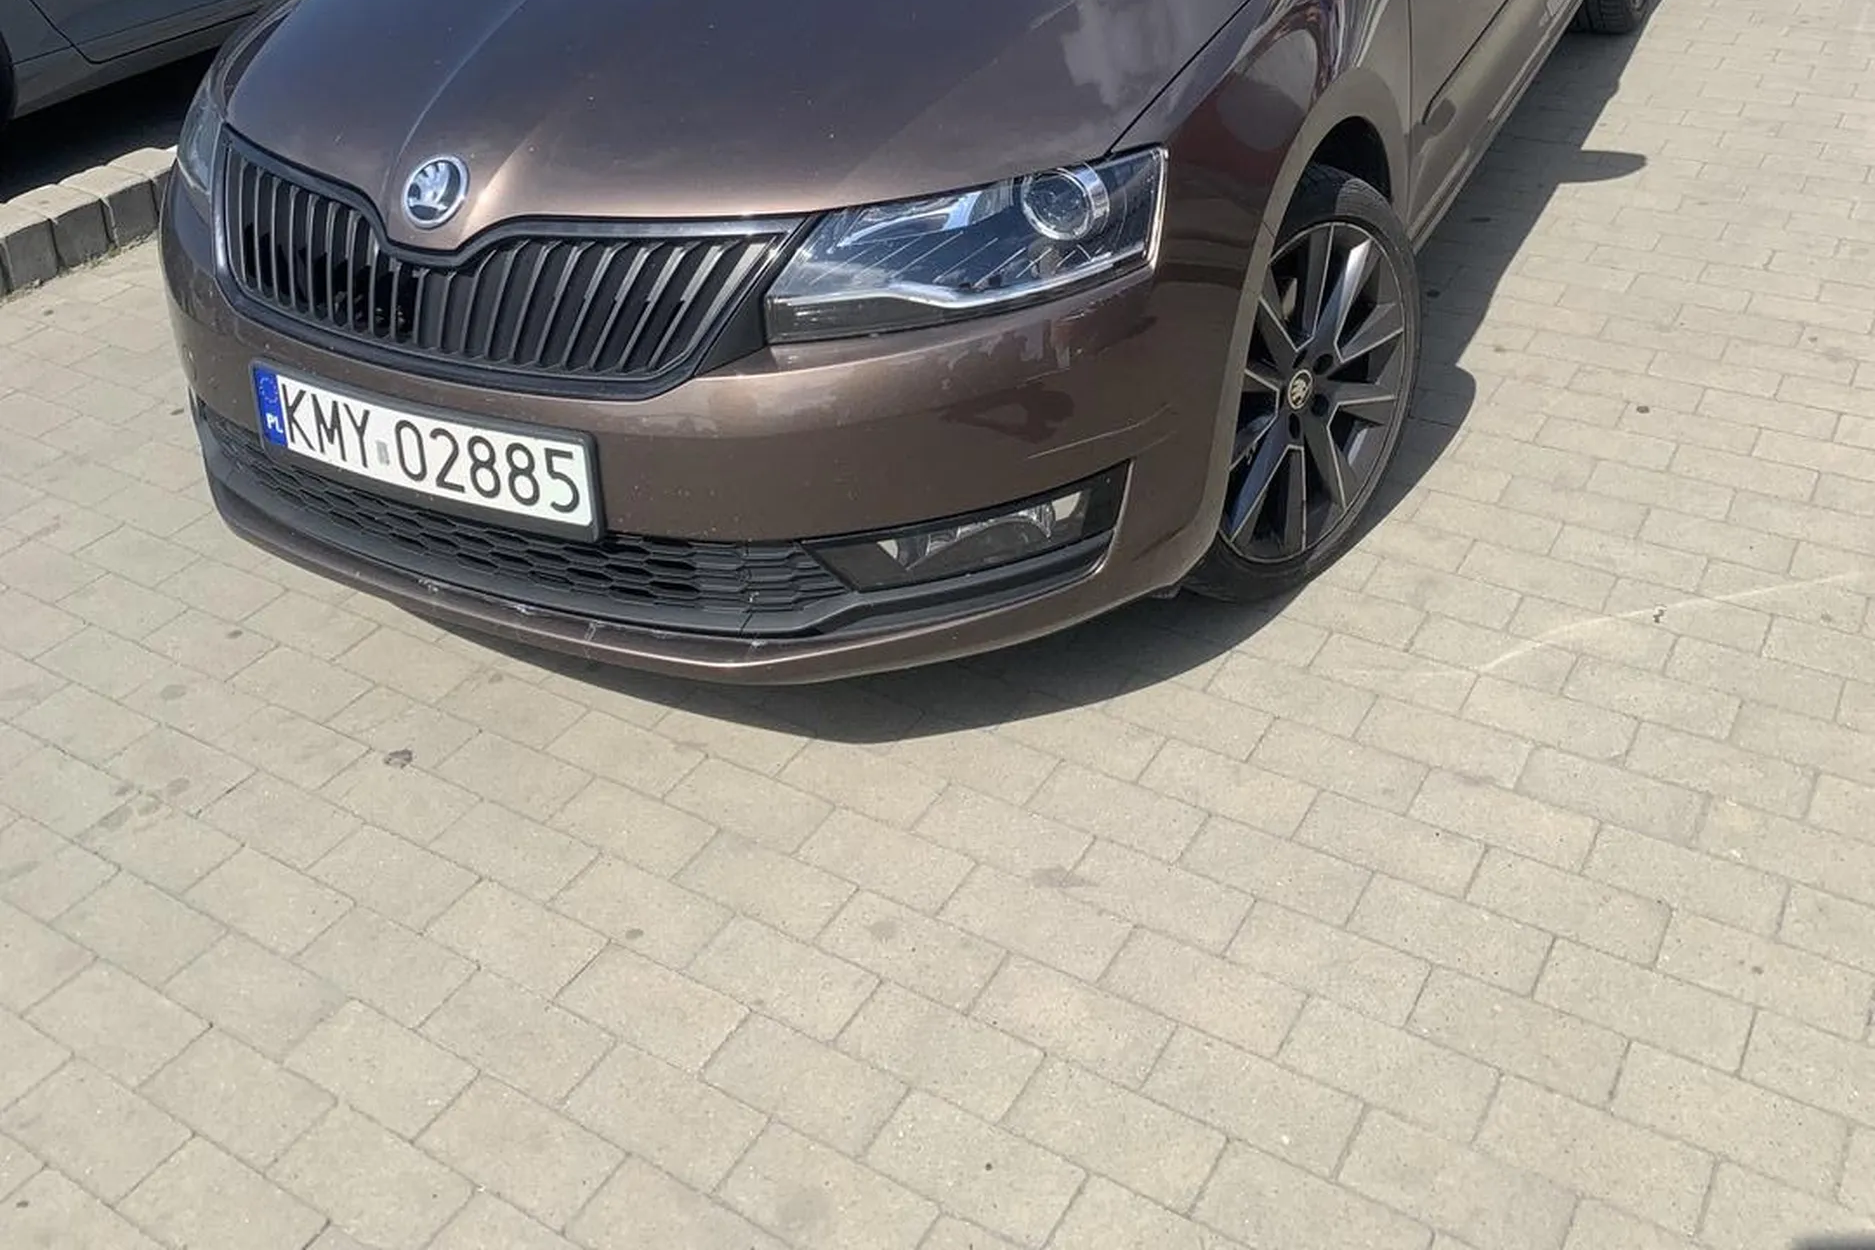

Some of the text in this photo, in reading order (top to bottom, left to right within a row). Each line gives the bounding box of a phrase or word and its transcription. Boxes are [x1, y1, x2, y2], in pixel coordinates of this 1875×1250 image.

[265, 413, 283, 434] PL
[282, 383, 580, 513] KMY 02885
